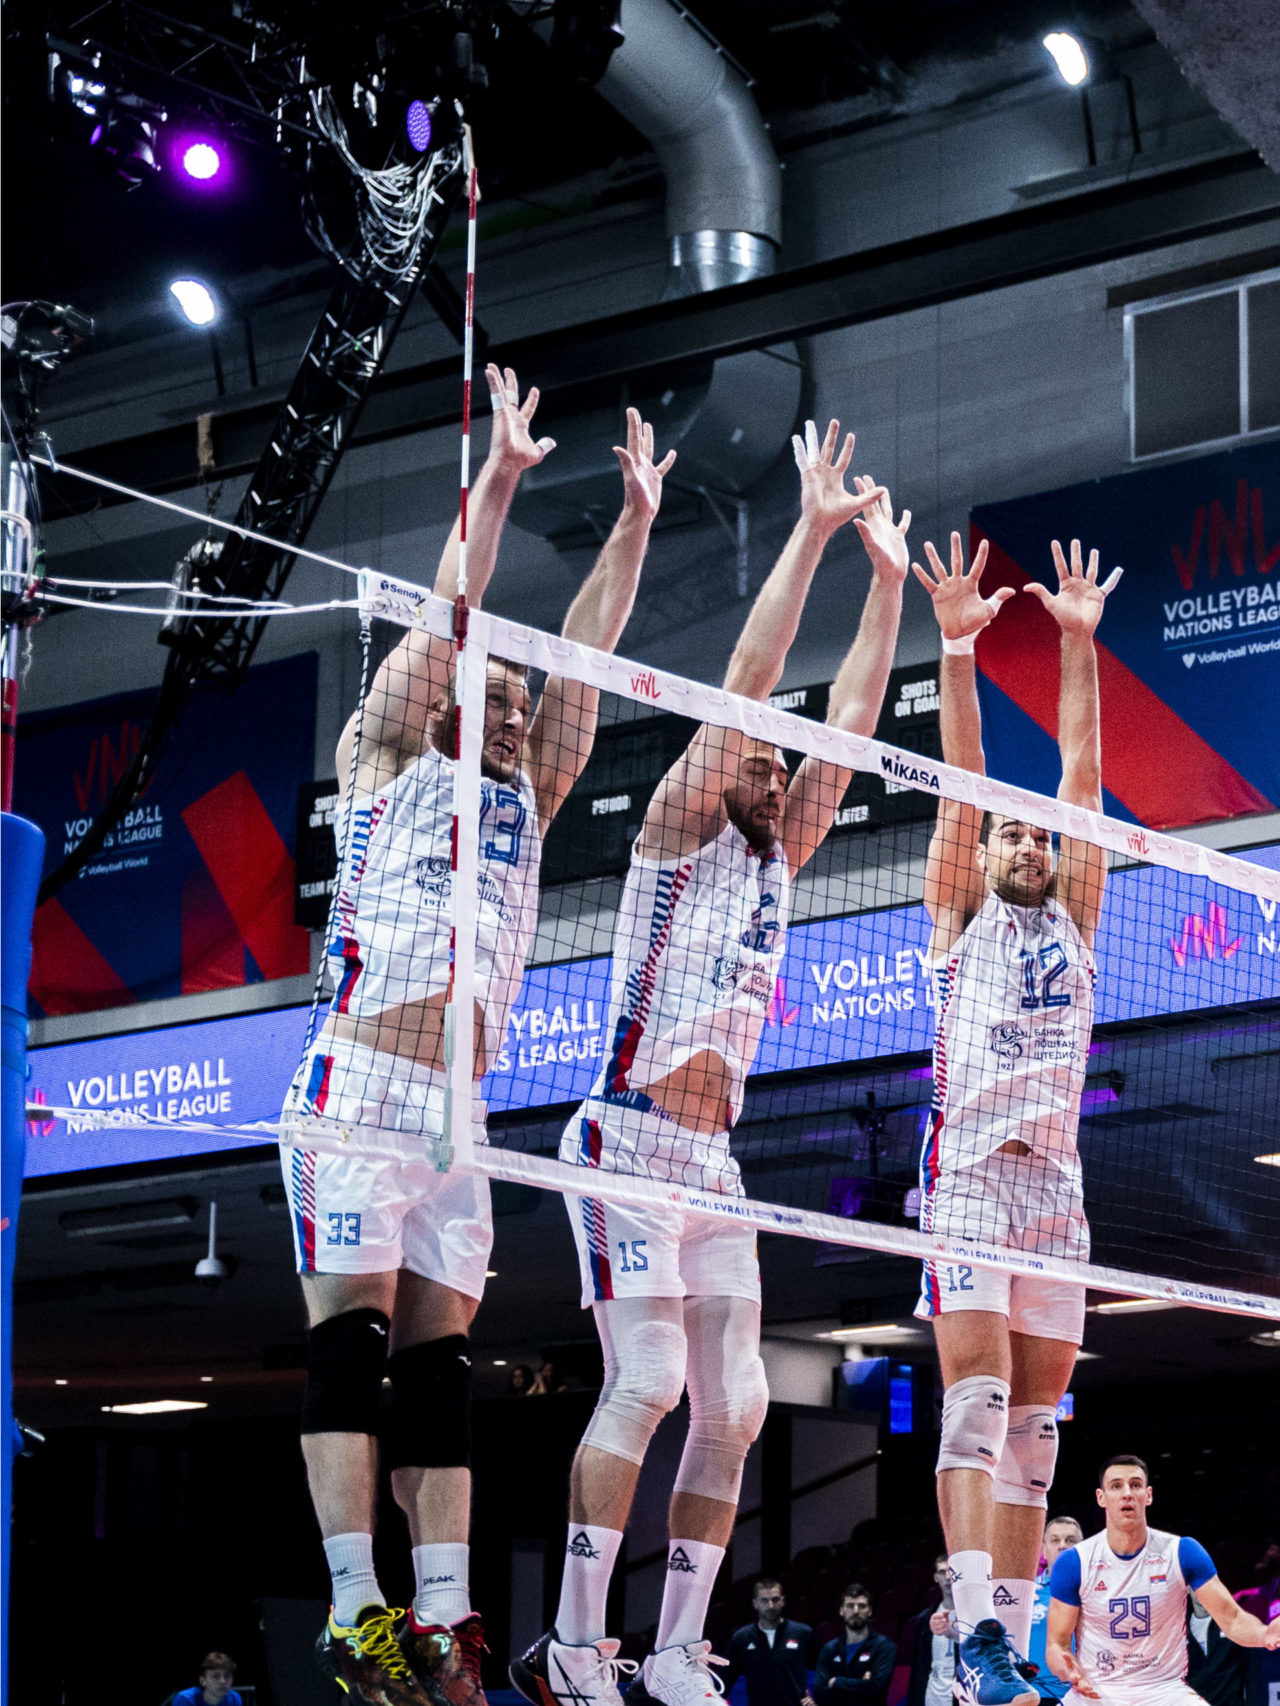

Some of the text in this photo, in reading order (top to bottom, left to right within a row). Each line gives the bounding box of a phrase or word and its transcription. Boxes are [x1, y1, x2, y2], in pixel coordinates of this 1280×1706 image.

[390, 584, 422, 601] Senoh
[1163, 614, 1233, 641] NATIONS
[1197, 645, 1246, 664] Volleyball
[767, 690, 807, 710] ENALTY
[900, 679, 936, 700] SHOTS
[894, 701, 911, 718] ON
[881, 755, 940, 790] MIKASA
[834, 805, 870, 826] LAYER
[1019, 942, 1072, 1009] 12
[812, 987, 916, 1024] NATIONS
[507, 1001, 601, 1042] YBALL
[519, 1036, 602, 1068] LEAGUE
[67, 1058, 232, 1107] VOLLEYBALL
[157, 1091, 232, 1120] LEAGUE
[327, 1213, 361, 1246] 33
[618, 1240, 648, 1272] 15
[946, 1264, 974, 1292] 12
[332, 1567, 350, 1577] EAK
[423, 1575, 456, 1586] PEAK
[992, 1598, 1020, 1606] EAK
[1109, 1595, 1151, 1639] 29
